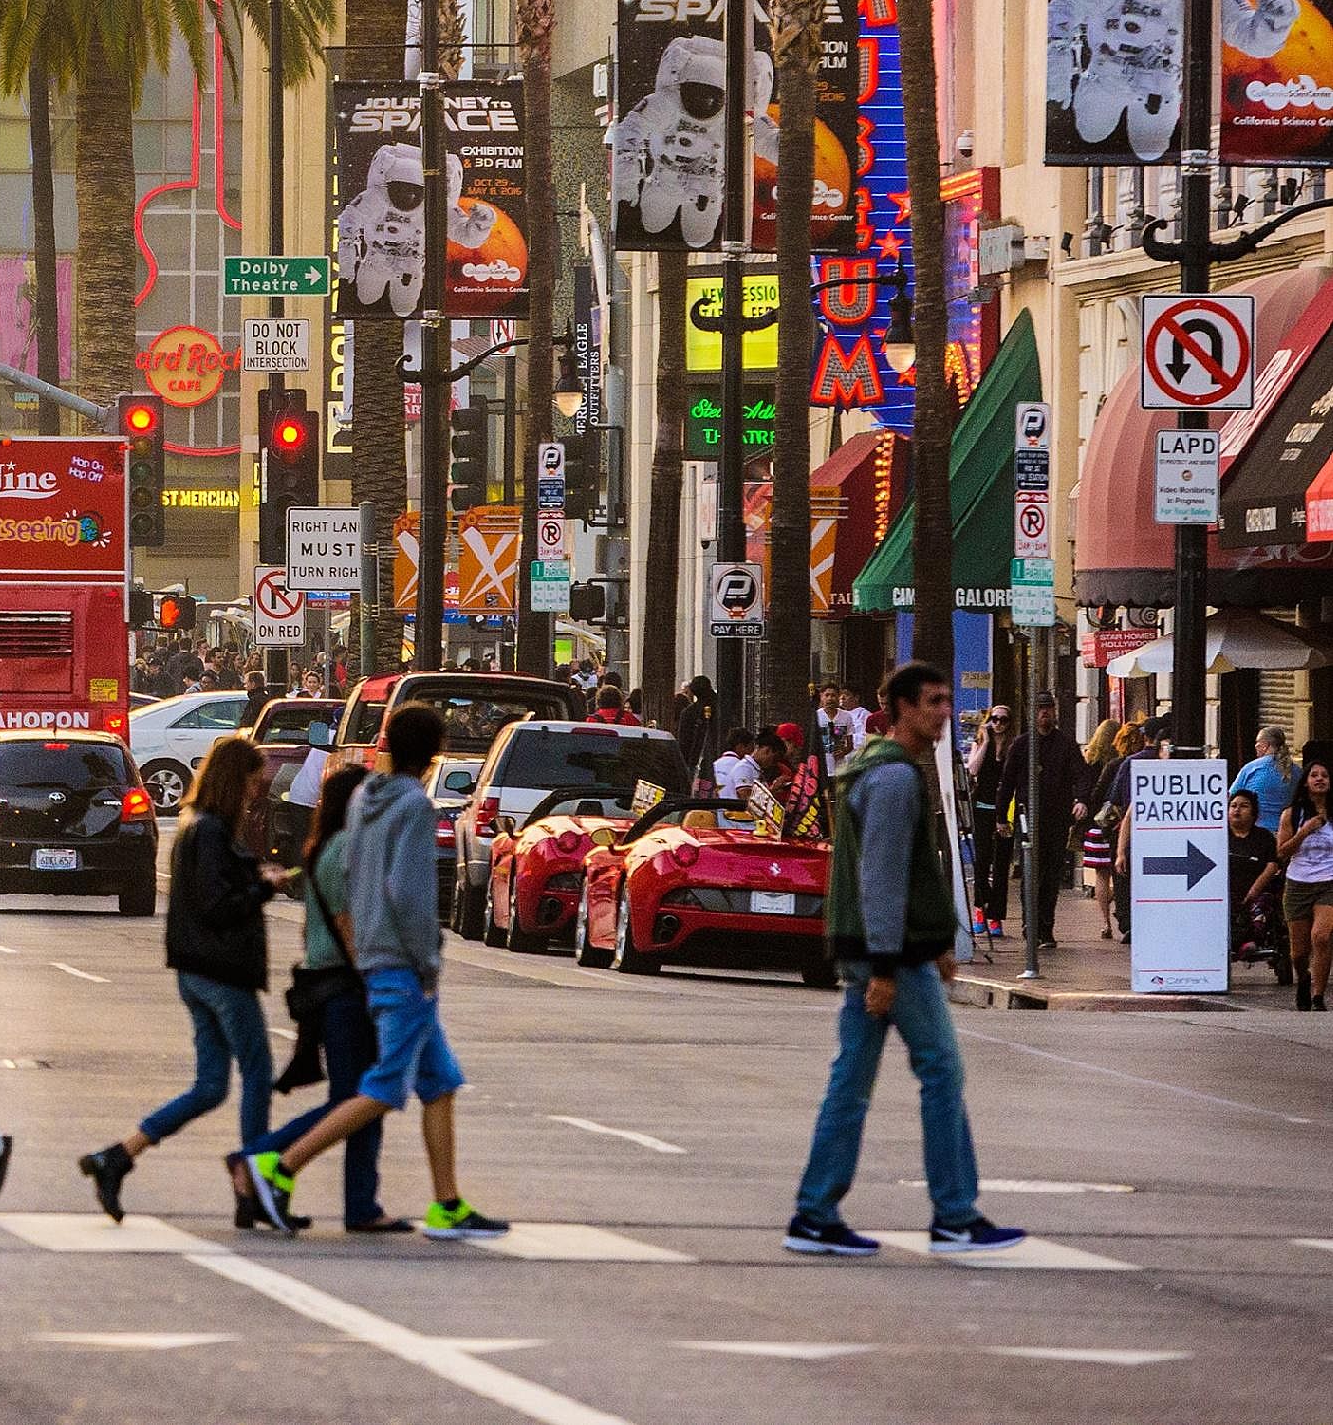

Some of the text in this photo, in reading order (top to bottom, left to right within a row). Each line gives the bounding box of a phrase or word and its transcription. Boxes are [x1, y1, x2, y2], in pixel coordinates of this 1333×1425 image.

[1233, 116, 1317, 126] California Science
[461, 146, 524, 156] EXHIBITION
[475, 159, 522, 169] 3D FILM
[240, 261, 289, 278] Dolby
[231, 278, 298, 291] Theatre
[252, 323, 301, 338] DO NOT
[255, 340, 297, 355] BLOCK
[577, 324, 588, 369] EAGLE
[135, 344, 184, 371] ard
[247, 357, 307, 368] INTERSECTION
[590, 351, 600, 425] OUTFITTERS
[1160, 437, 1215, 454] LAPD
[292, 521, 360, 533] RIGHT LAN
[301, 543, 355, 557] MUST
[291, 567, 324, 578] TURN
[259, 625, 301, 638] ON RED
[713, 625, 760, 634] PAY HERE
[1125, 632, 1156, 640] HOMES
[1136, 774, 1223, 796] PUBLIC
[1135, 800, 1224, 822] PARKING
